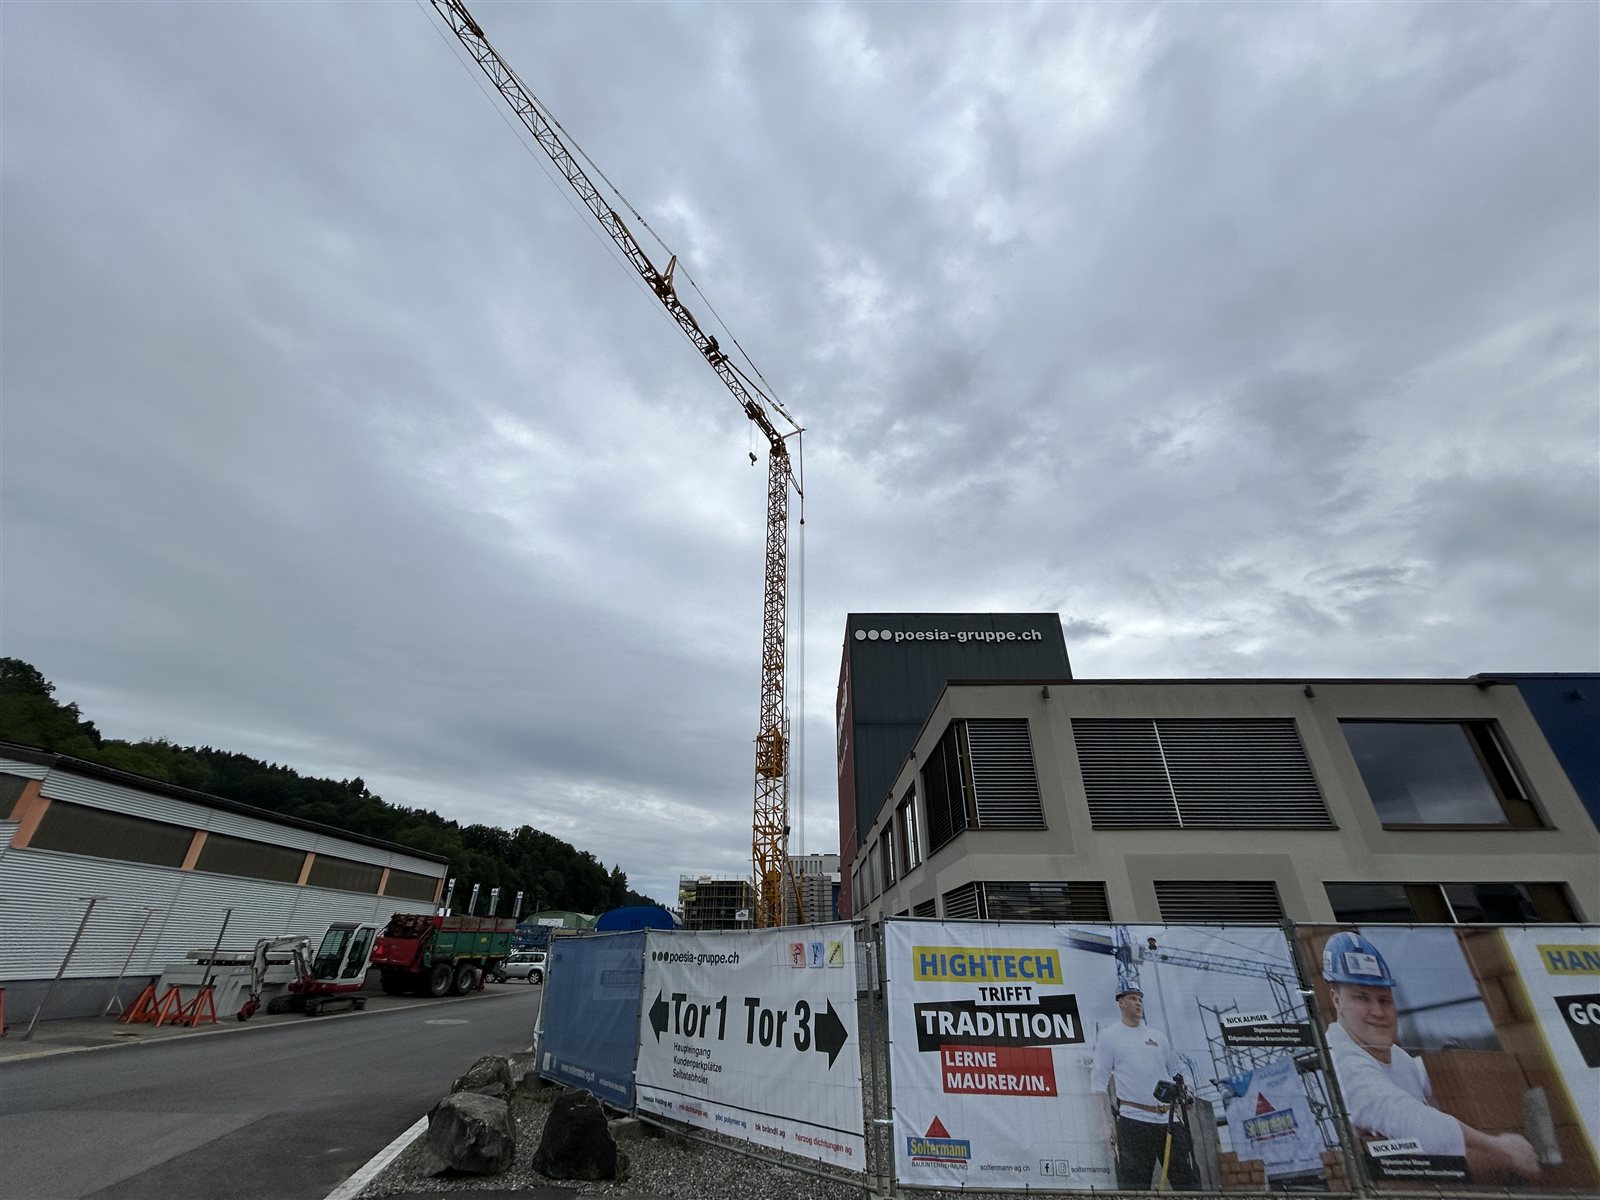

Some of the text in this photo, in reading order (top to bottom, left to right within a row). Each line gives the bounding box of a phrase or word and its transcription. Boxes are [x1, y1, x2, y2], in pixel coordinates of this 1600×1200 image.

[894, 629, 1042, 643] poesia-gruppe.ch
[669, 951, 740, 966] poesia-gruppe.ch
[920, 953, 1055, 979] HIGHTECH
[978, 987, 1032, 1001] TRIFFT
[672, 992, 728, 1041] Tor 1
[744, 997, 811, 1052] Tor 3
[920, 1010, 1076, 1039] TRADITION
[1226, 1014, 1269, 1024] NICK ALPIGER
[673, 1042, 711, 1059] Haupteingang
[673, 1056, 722, 1073] Kundenparkplätze
[945, 1051, 997, 1068] LERNE
[672, 1068, 708, 1084] Selbstabholer
[946, 1072, 1051, 1092] MAURER/IN.
[740, 1120, 747, 1128] ag
[779, 1129, 786, 1139] ag
[795, 1132, 853, 1156] herzog dichtungen ag
[911, 1138, 968, 1157] Soltermann
[1373, 1145, 1389, 1153] NICK
[980, 1163, 1031, 1173] soltermann-ag.ch
